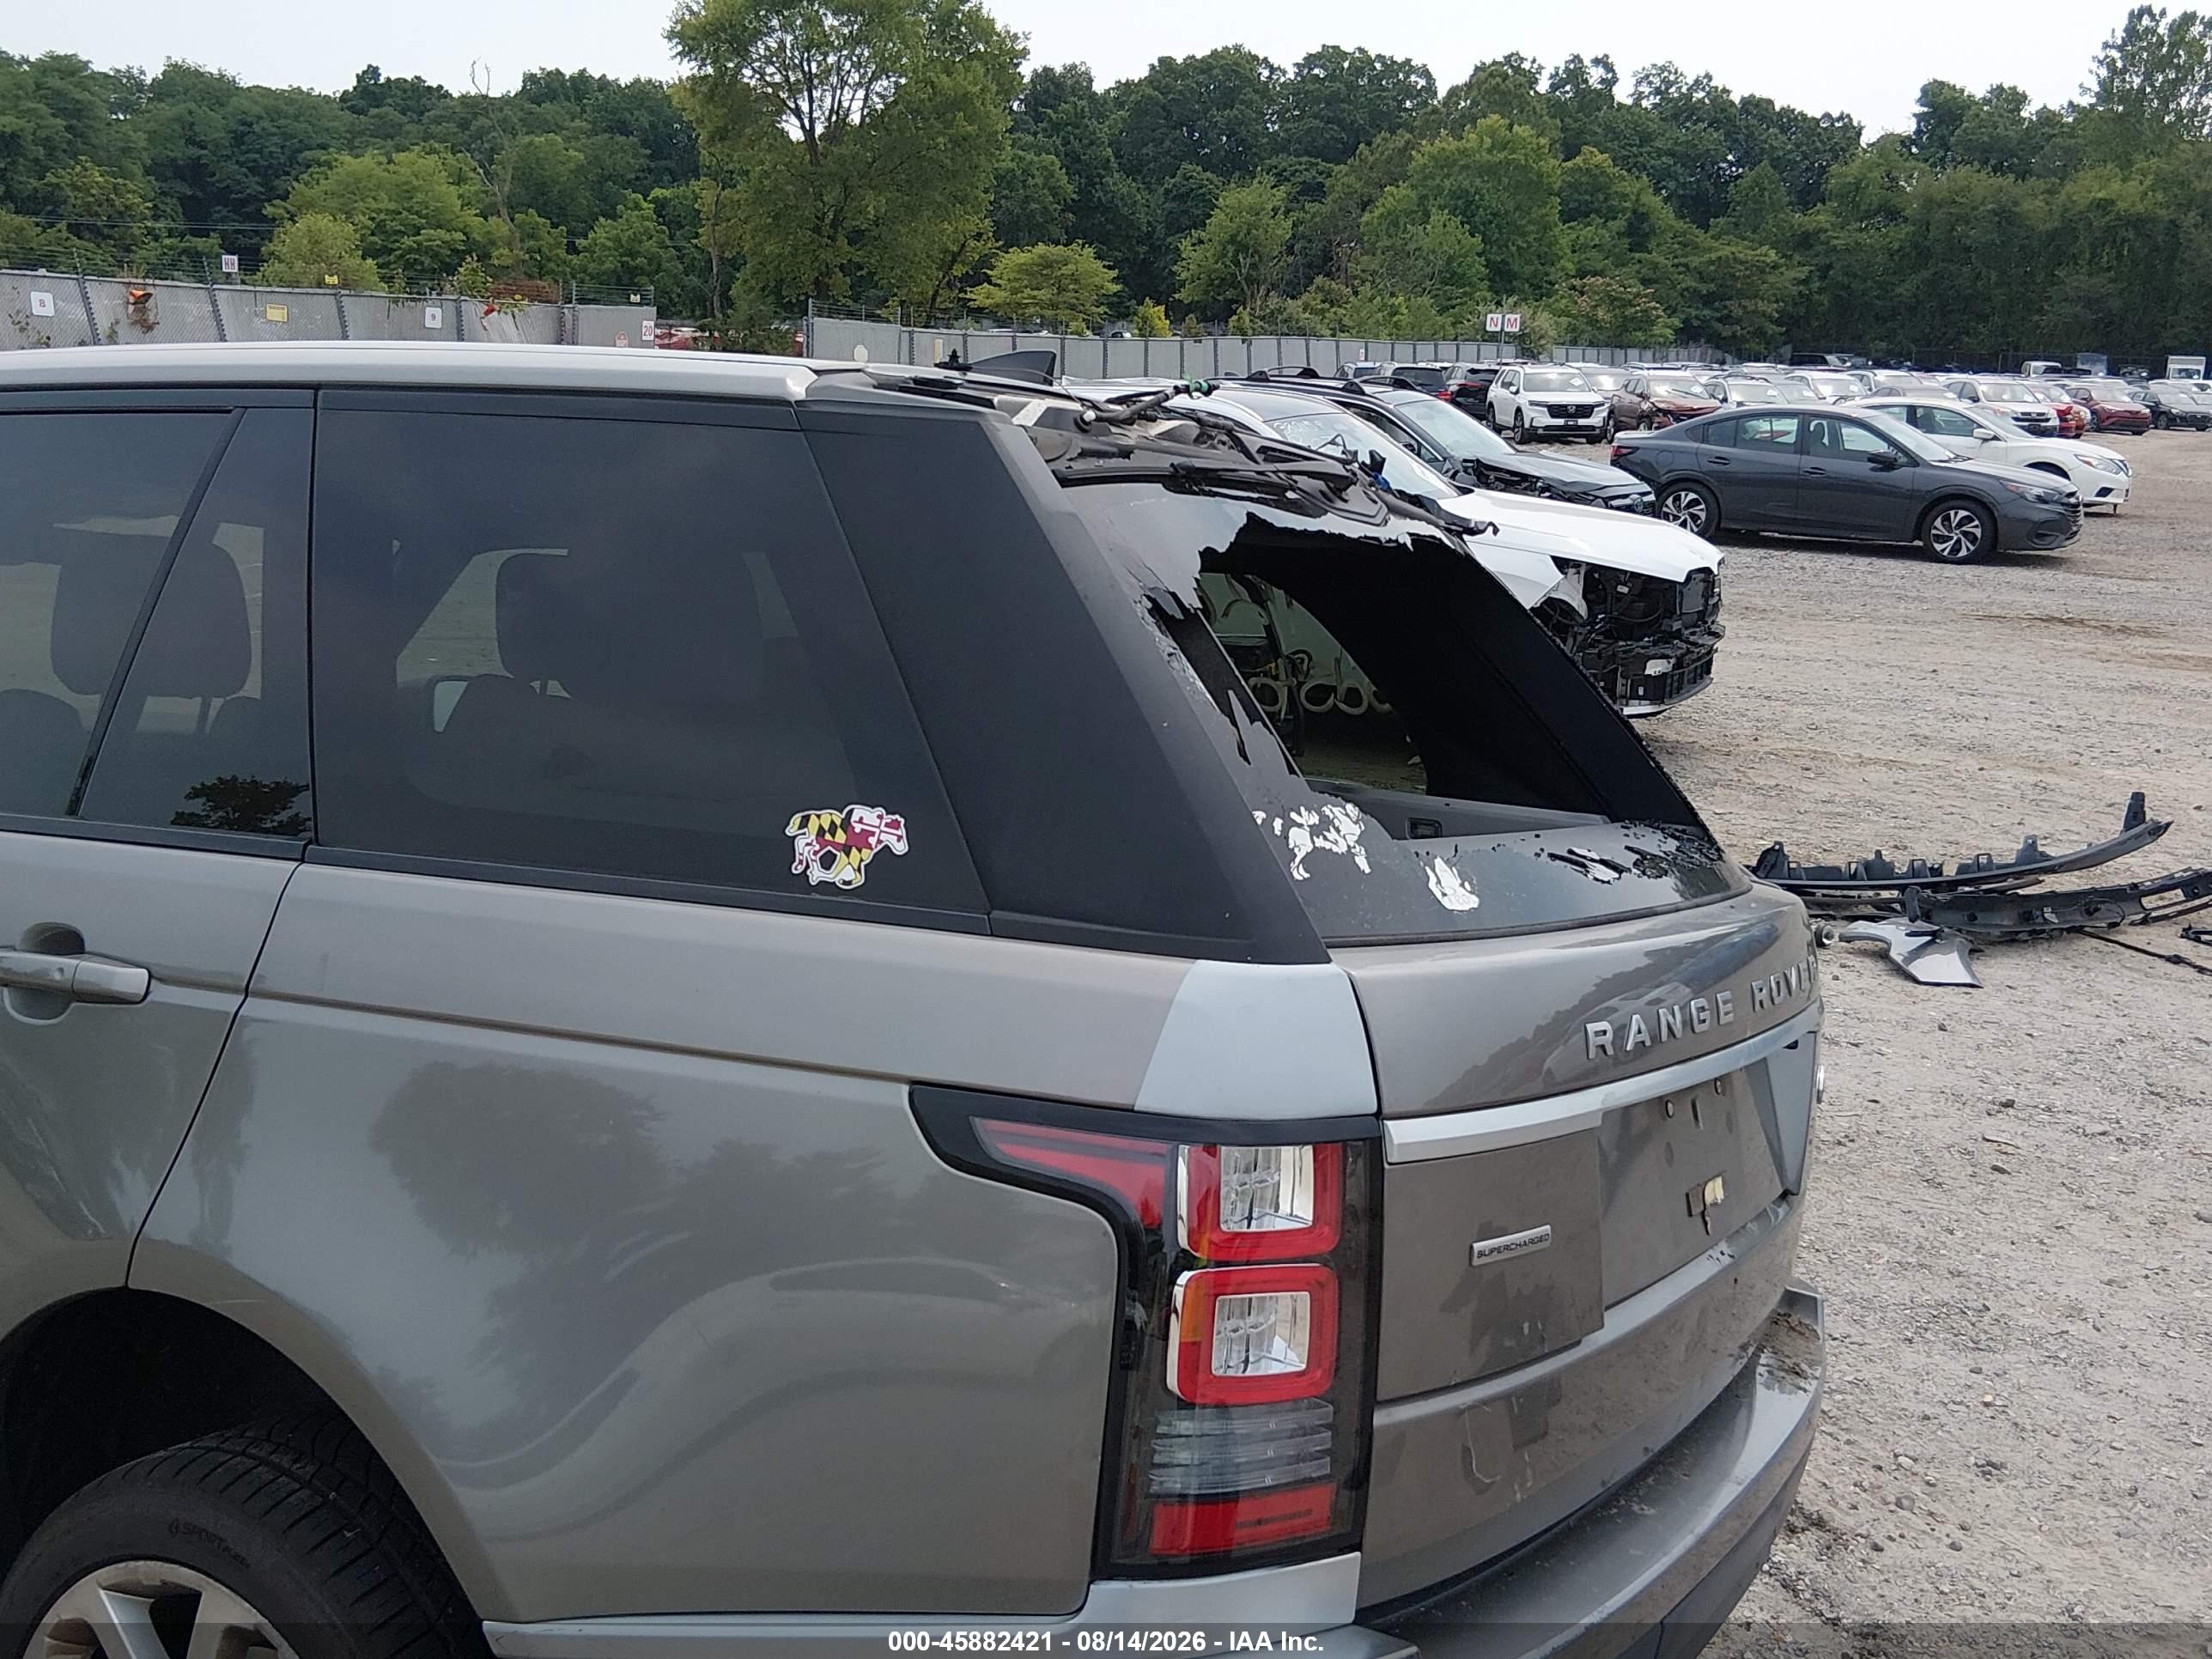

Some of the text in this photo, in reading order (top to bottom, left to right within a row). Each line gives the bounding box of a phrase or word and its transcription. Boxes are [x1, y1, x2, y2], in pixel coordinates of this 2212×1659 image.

[1489, 316, 1498, 328] N
[1506, 317, 1518, 329] M
[643, 325, 653, 337] 20
[1585, 990, 1735, 1060] RANGE
[1476, 1233, 1550, 1259] SUPERCHARGED
